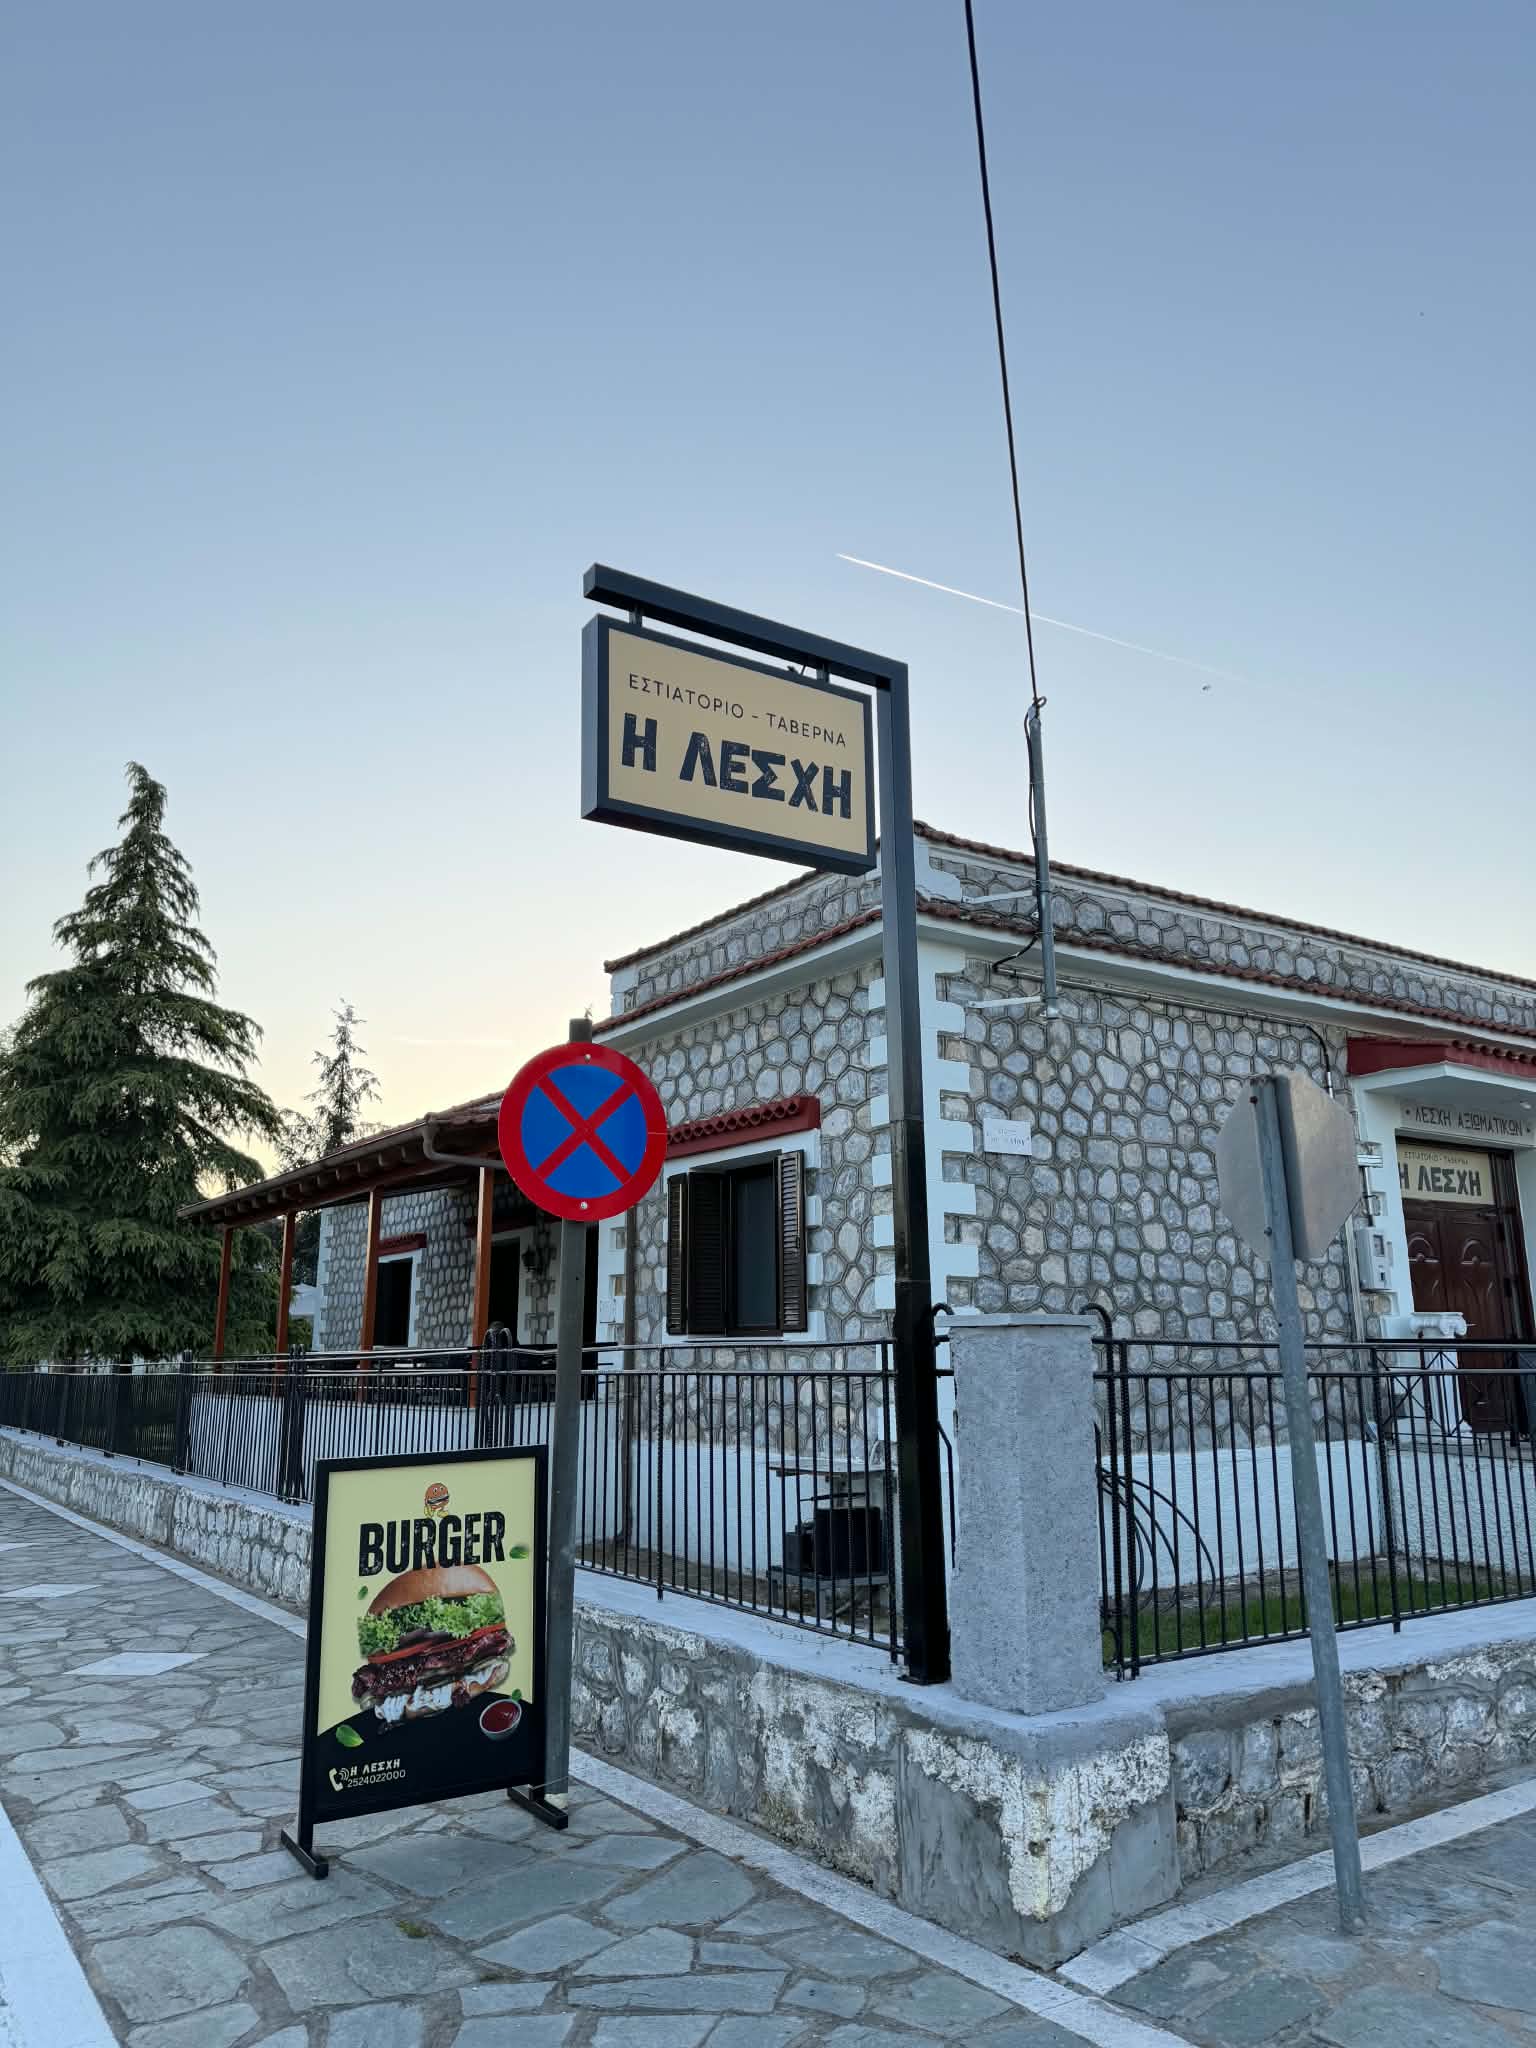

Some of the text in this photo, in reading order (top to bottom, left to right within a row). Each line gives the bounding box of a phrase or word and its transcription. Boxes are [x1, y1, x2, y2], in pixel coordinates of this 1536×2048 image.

[629, 672, 745, 719] ΕΣΤΙΑΤΟΡΙΟ
[766, 712, 847, 748] ΤΑΒΕΡΝΑ
[621, 712, 852, 820] Η ΛΕΣΧΗ
[1415, 1106, 1452, 1128] ΛΕΣΧΗ
[1418, 1165, 1482, 1197] ΛΕΣΧΗ
[358, 1511, 506, 1577] BURGER
[347, 1769, 406, 1788] 2524022000
[350, 1758, 401, 1777] Η ΛΕΣΧΗ
